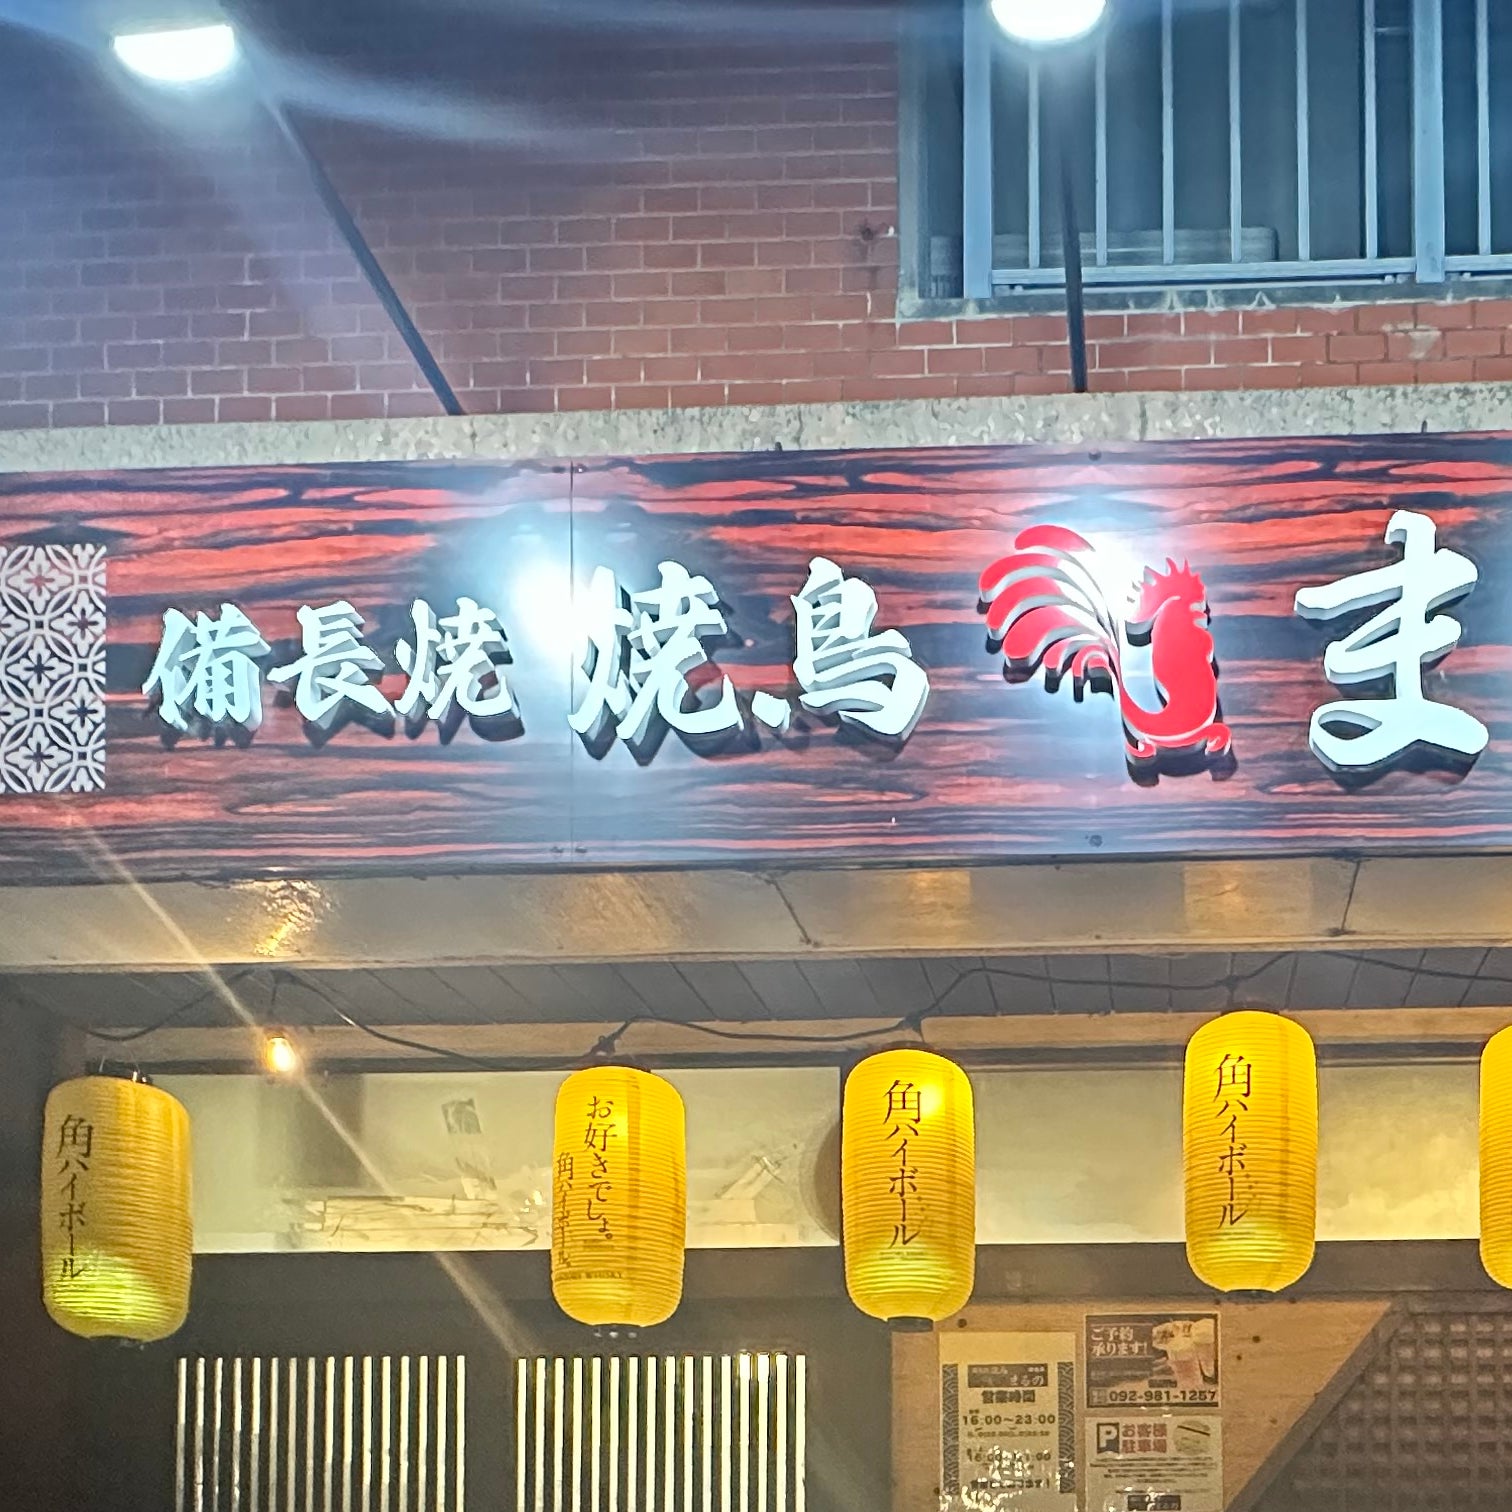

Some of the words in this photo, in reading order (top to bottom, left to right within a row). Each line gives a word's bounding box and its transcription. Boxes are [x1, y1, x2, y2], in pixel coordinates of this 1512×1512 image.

[141, 595, 517, 735] 備長焼
[568, 555, 932, 742] 焼鳥
[56, 1114, 93, 1279] 角ハイボール
[584, 1095, 618, 1240] お好きでしょ。
[882, 1079, 922, 1249] 角ハイボール
[1213, 1053, 1252, 1230] 角ハイボール
[1099, 1424, 1118, 1449] P
